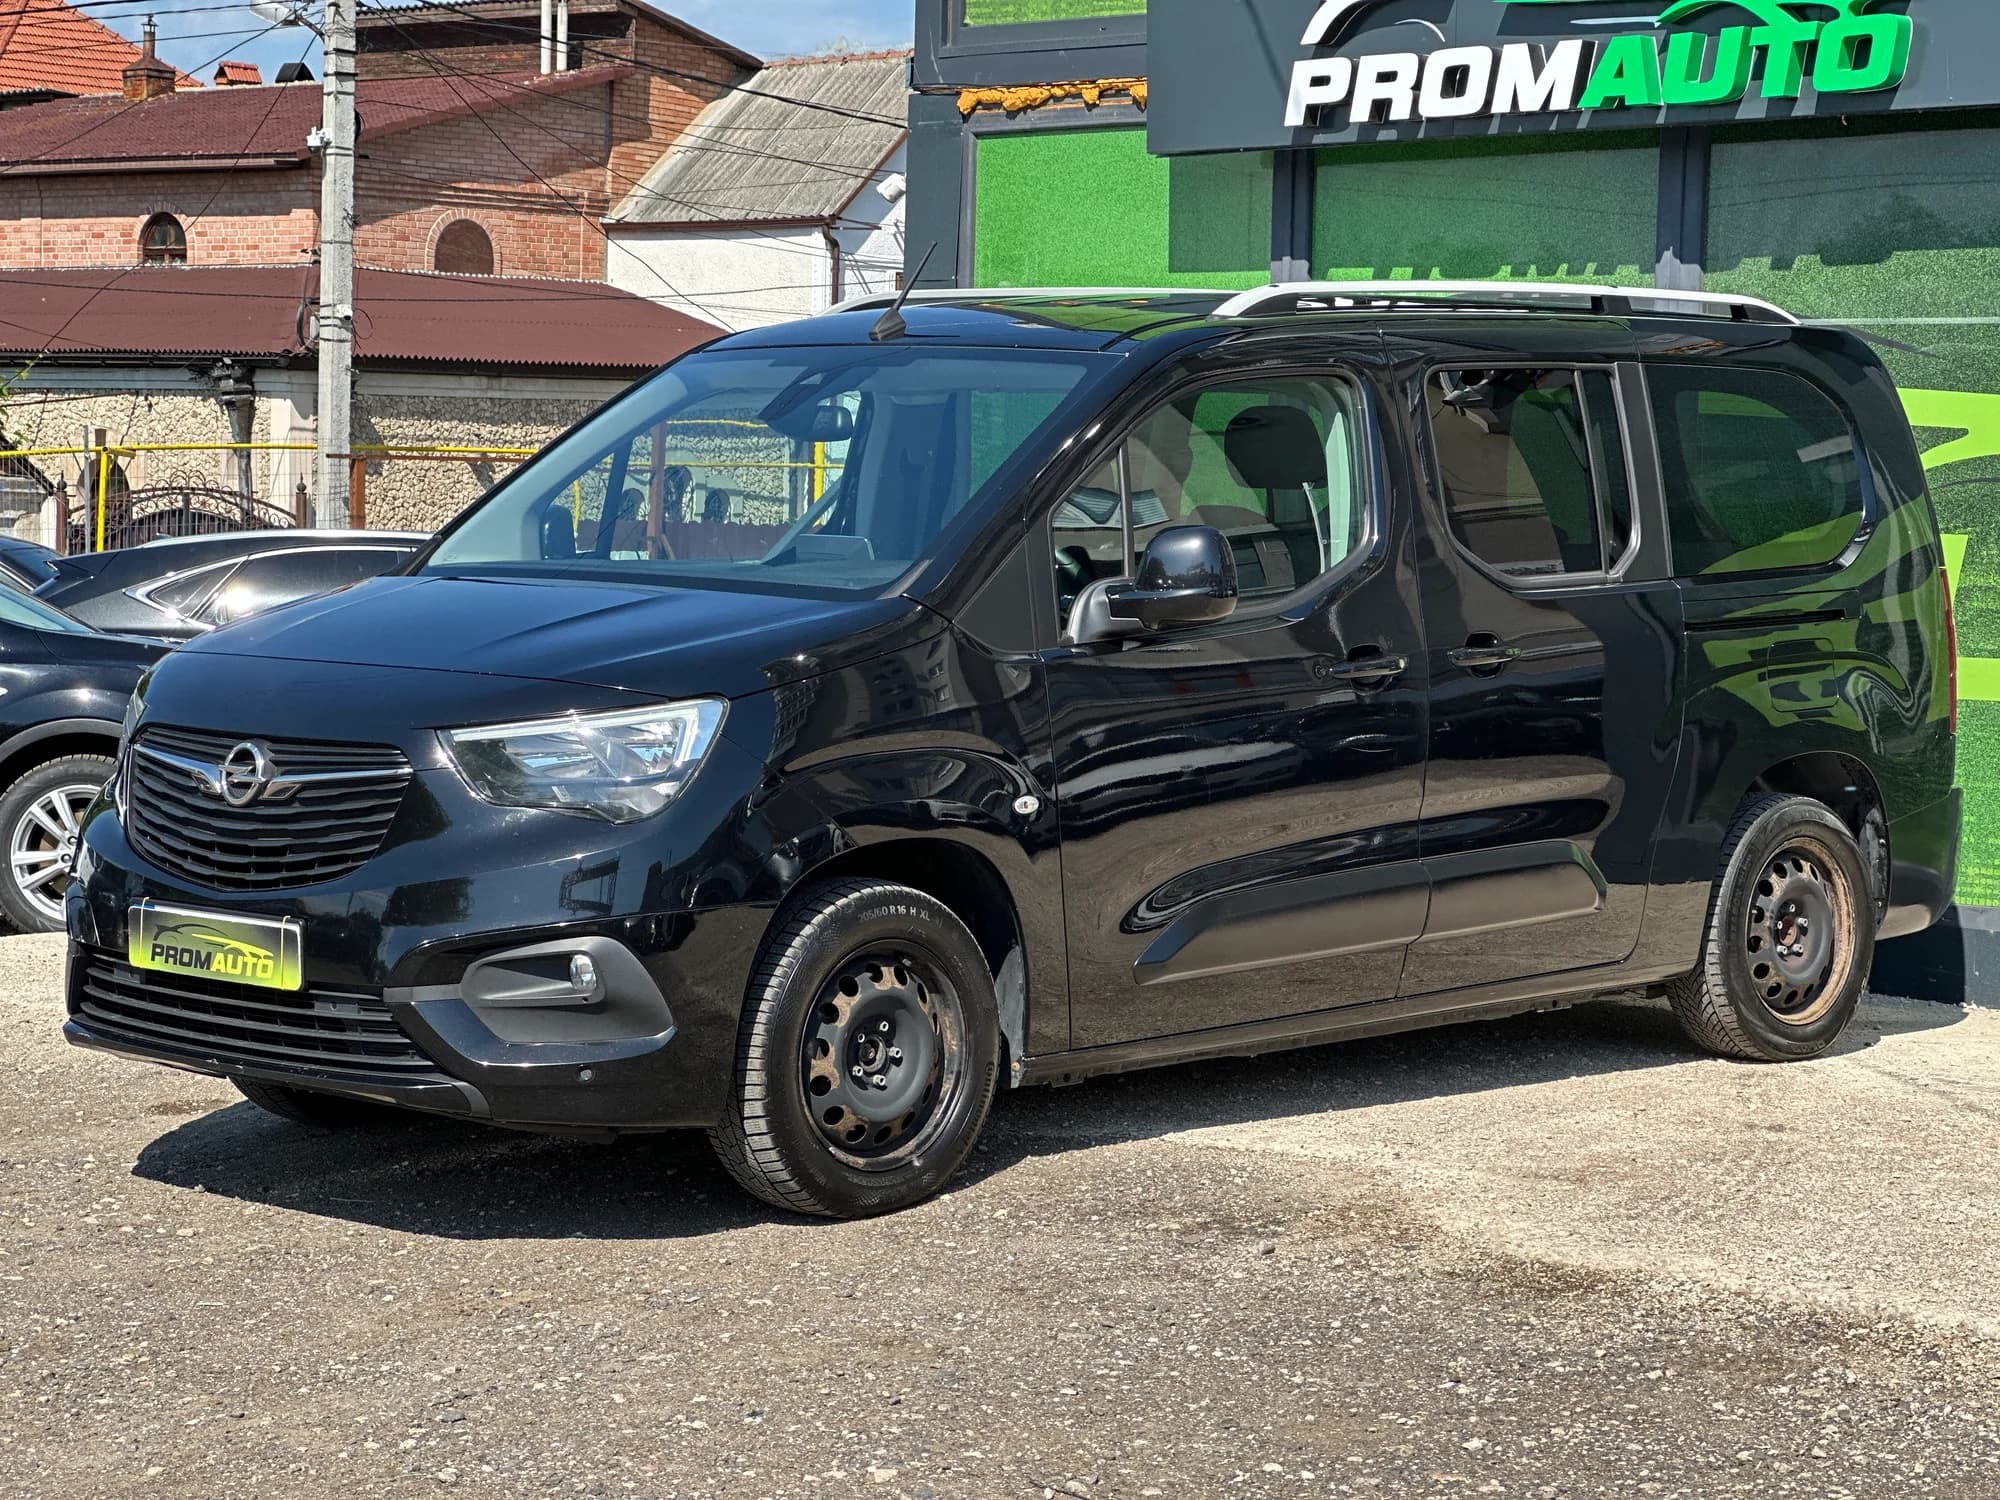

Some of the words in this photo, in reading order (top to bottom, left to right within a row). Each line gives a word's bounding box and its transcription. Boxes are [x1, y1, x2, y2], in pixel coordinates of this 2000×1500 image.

[1283, 14, 1913, 128] PROMAUTO
[909, 905, 917, 917] H
[919, 909, 930, 921] XL
[151, 943, 274, 979] PROMAUTO
